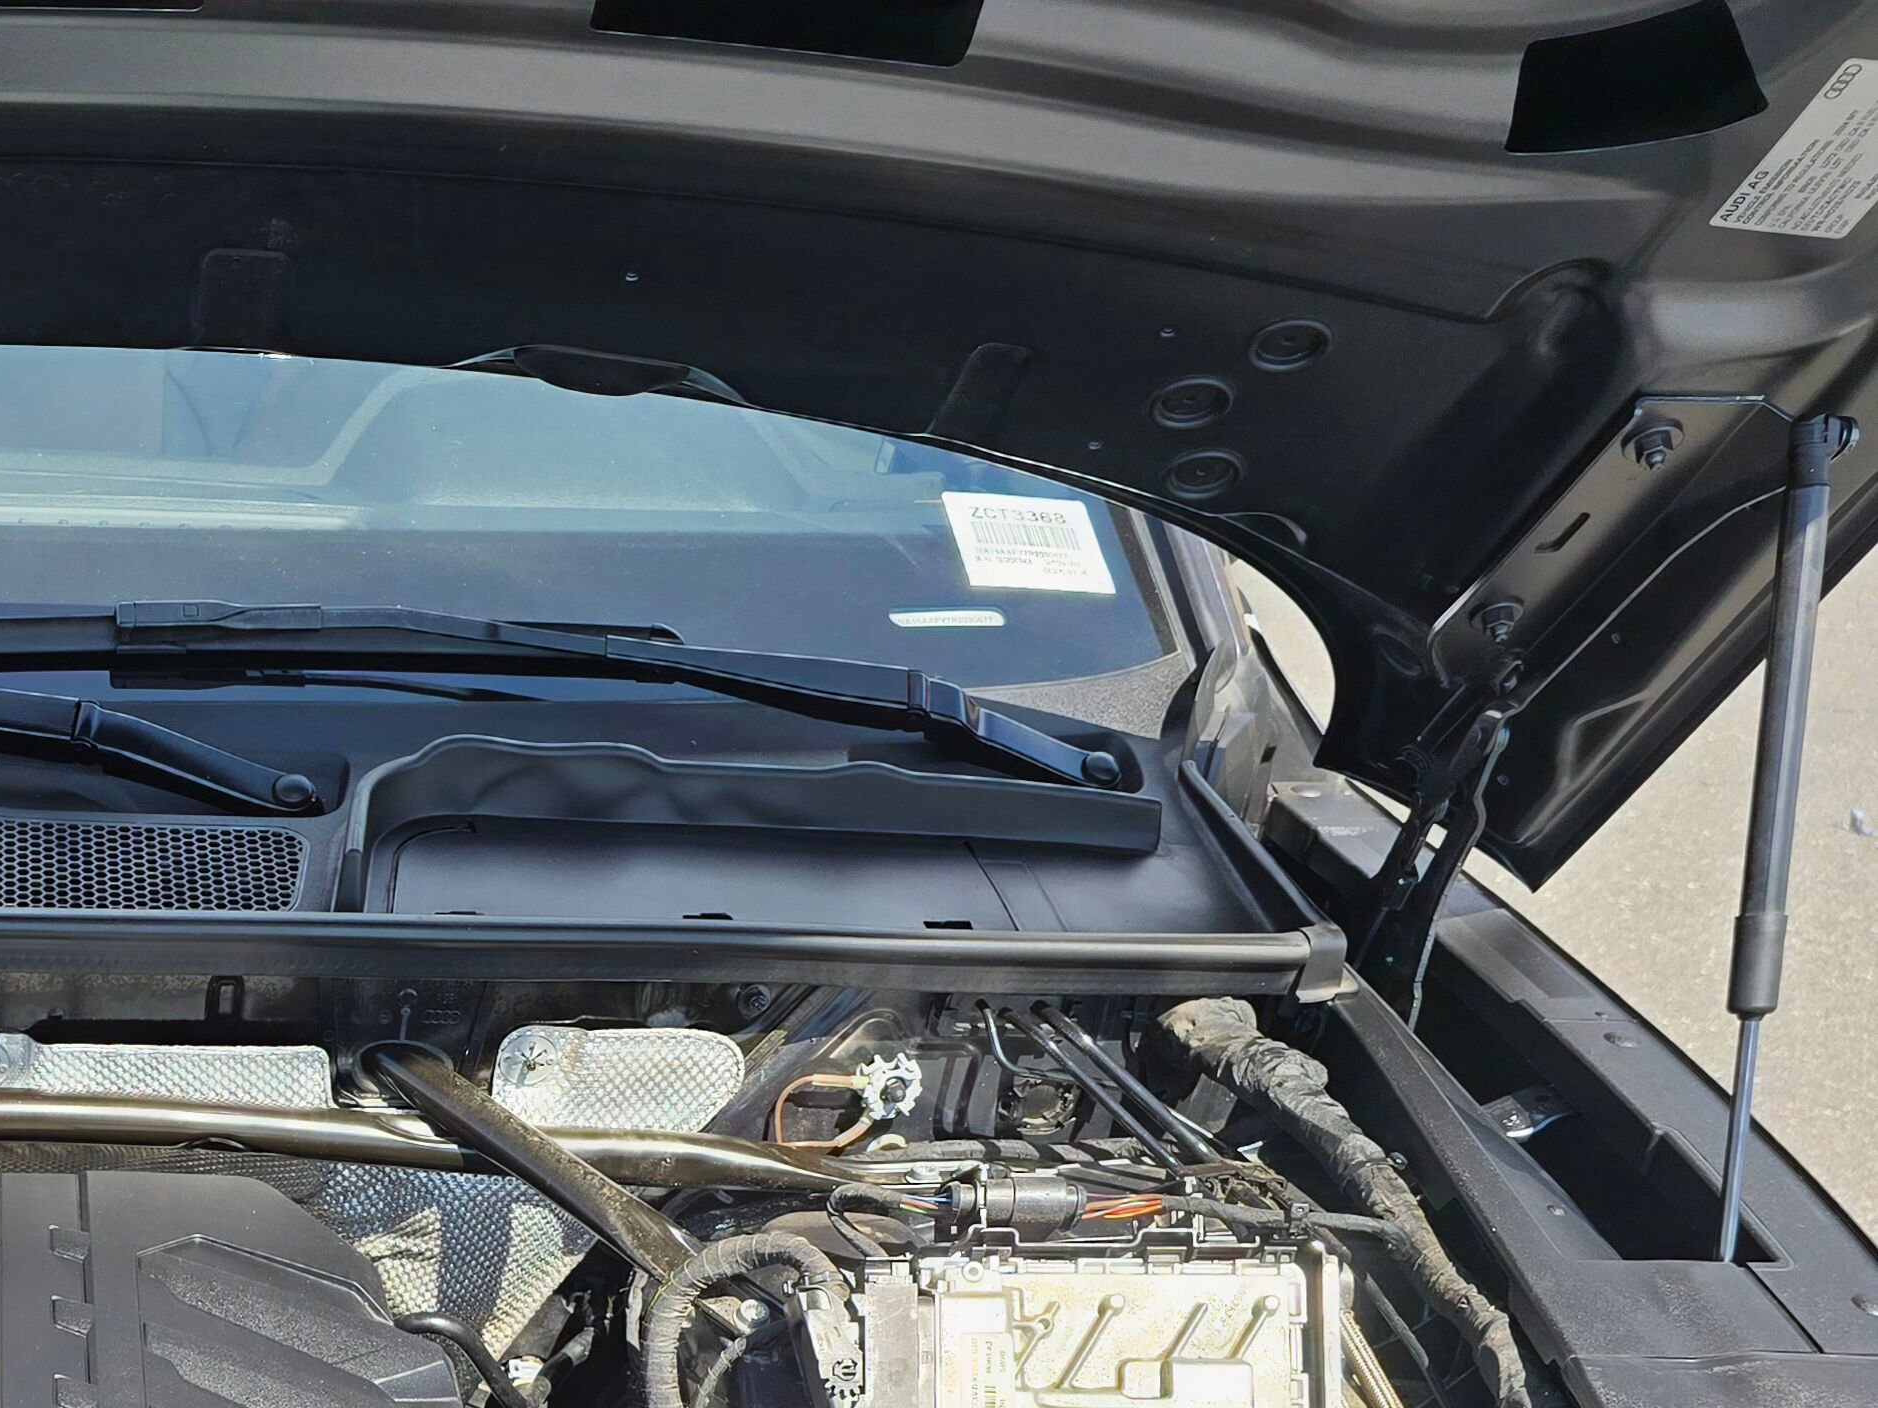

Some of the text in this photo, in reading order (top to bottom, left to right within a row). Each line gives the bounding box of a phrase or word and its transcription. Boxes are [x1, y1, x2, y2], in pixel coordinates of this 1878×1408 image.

[1720, 171, 1769, 222] AUDI AG
[969, 507, 1066, 524] ZCT3368
